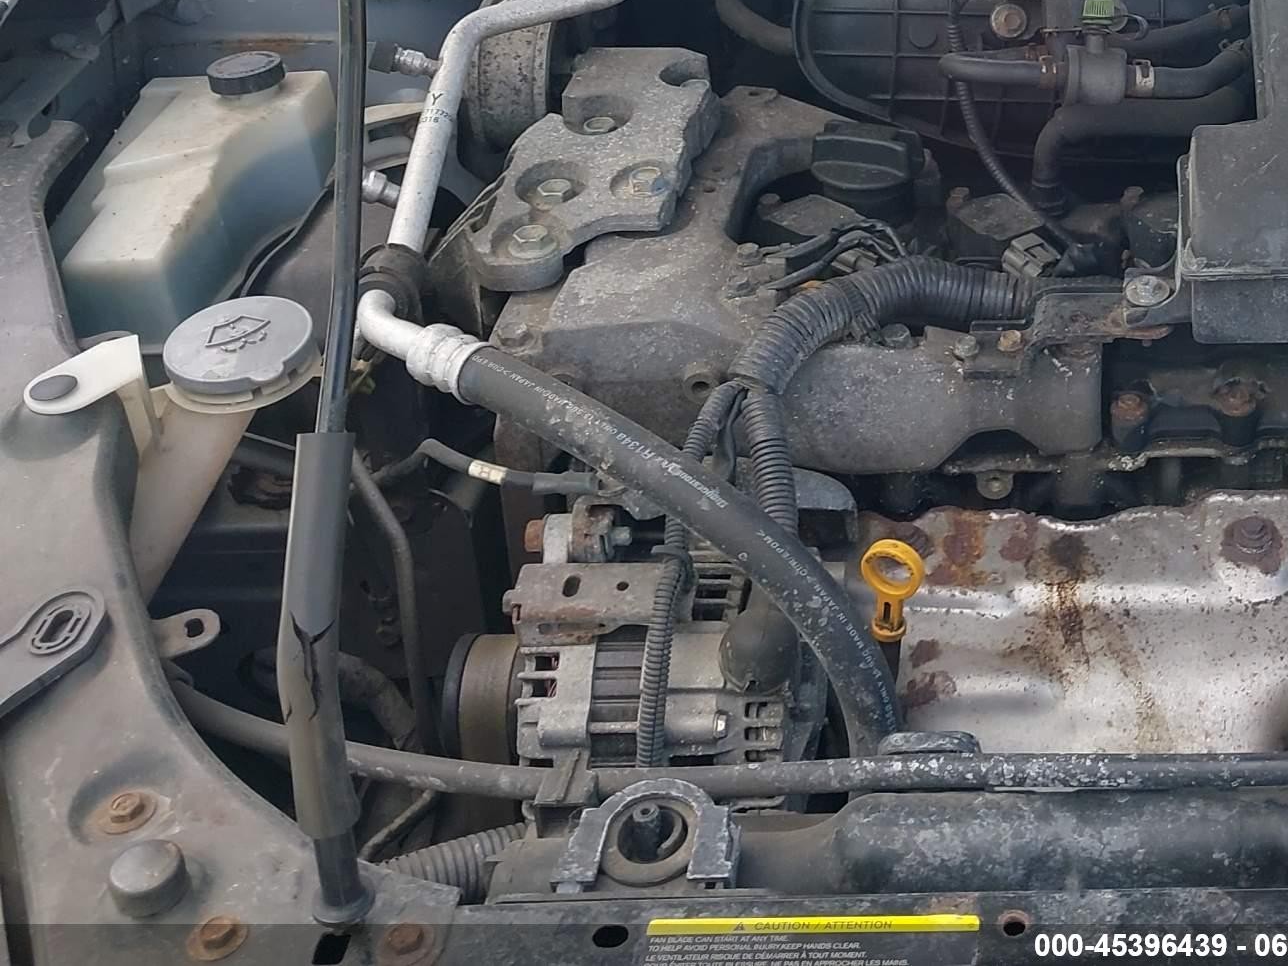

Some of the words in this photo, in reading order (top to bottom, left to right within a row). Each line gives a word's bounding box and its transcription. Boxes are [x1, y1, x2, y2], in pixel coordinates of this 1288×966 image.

[510, 372, 535, 389] JAPAN
[813, 582, 841, 611] JAPAN
[836, 611, 849, 624] IN
[845, 623, 865, 649] MADE
[754, 922, 809, 930] CAUTION
[823, 921, 892, 930] ATTENTION
[660, 944, 683, 952] HELP
[709, 943, 751, 951] PERSONAL
[803, 942, 832, 950] HANDS
[645, 954, 656, 962] LE
[657, 953, 709, 961] VENTILATEUR
[742, 952, 754, 960] DE
[808, 951, 829, 959] TOUT
